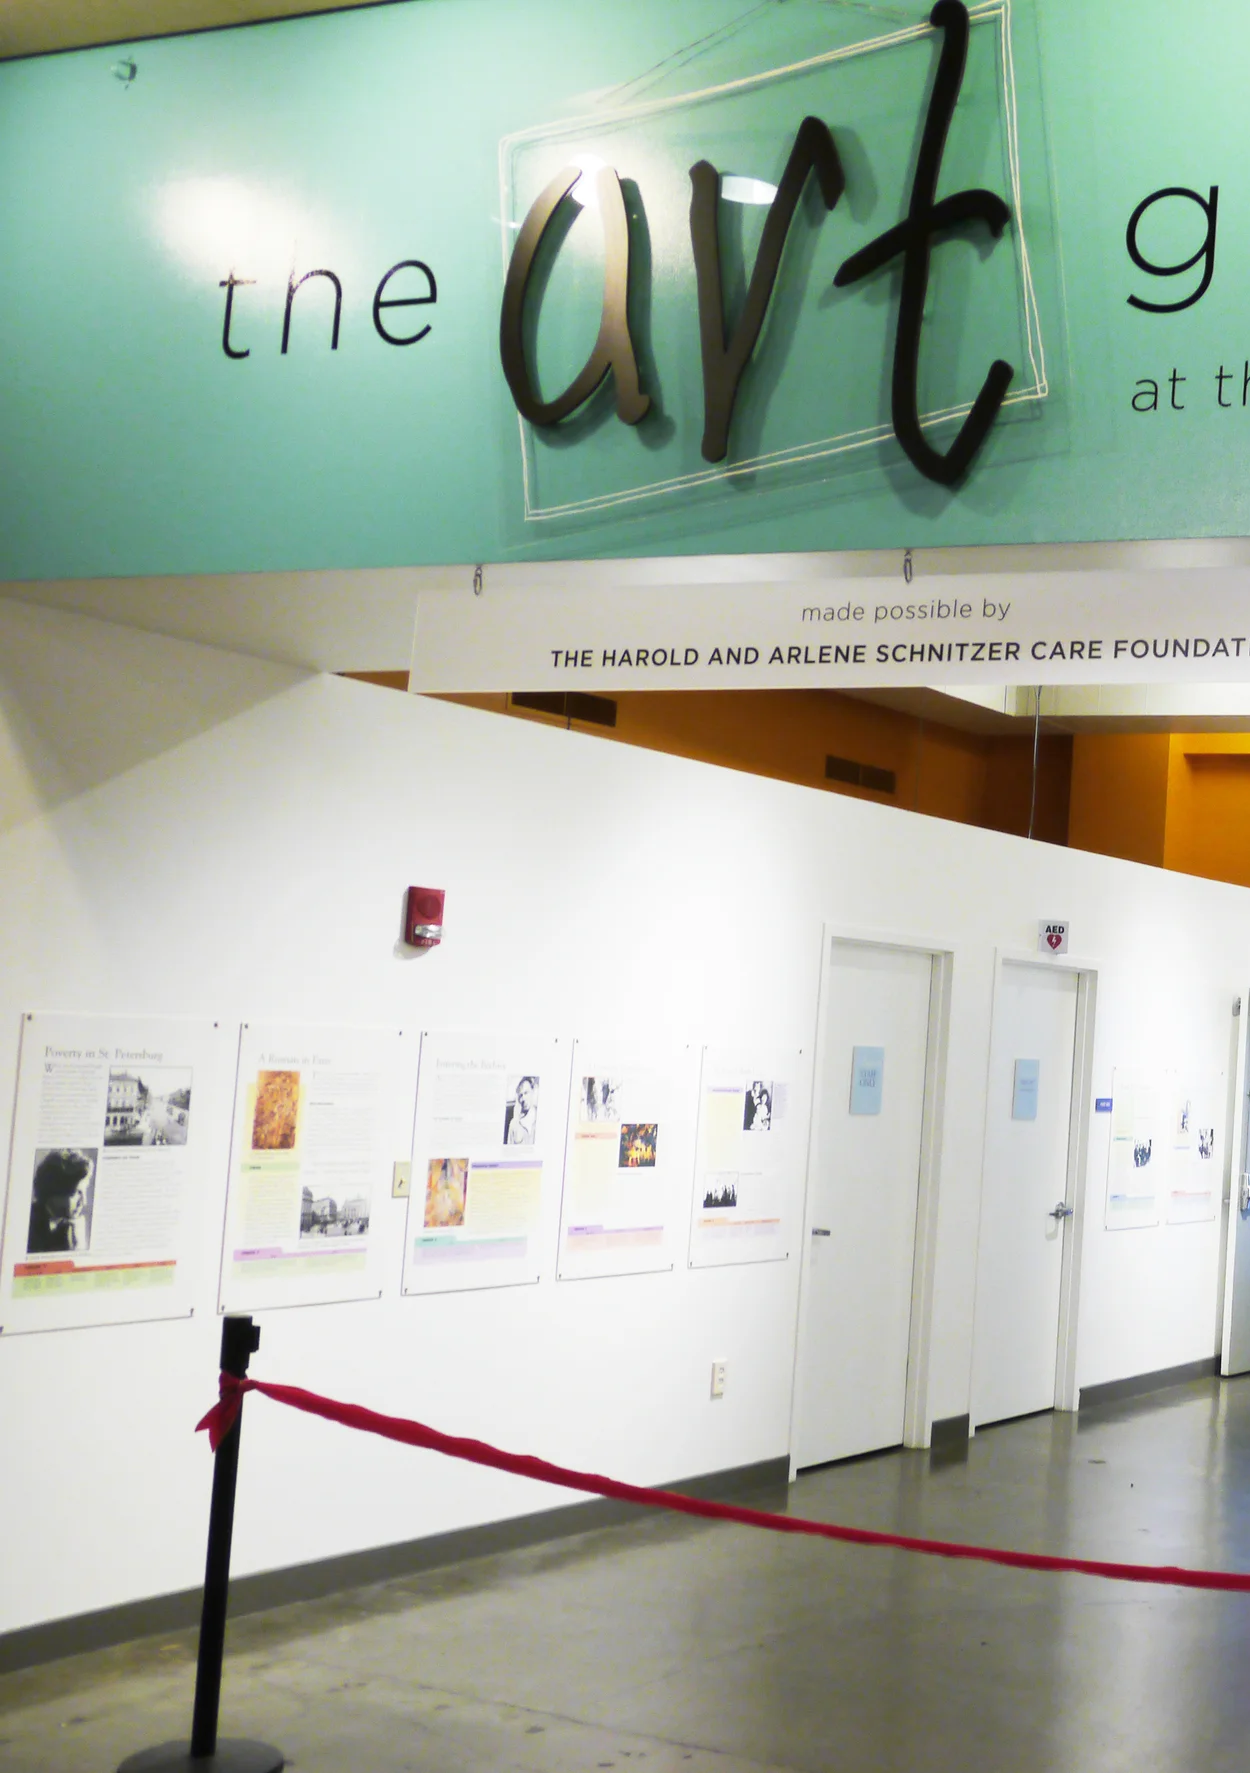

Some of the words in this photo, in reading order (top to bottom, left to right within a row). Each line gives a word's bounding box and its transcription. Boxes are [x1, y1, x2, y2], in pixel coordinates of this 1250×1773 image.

[219, 250, 438, 360] the
[499, 0, 1013, 488] art
[1130, 366, 1187, 412] at
[802, 601, 865, 622] made
[873, 599, 973, 624] possible
[982, 598, 1012, 621] by
[550, 649, 594, 668] THE
[601, 647, 699, 668] HAROLD
[708, 646, 760, 667] AND
[768, 644, 867, 666] ARLENE
[875, 642, 1021, 664] SCHNITZER
[1031, 639, 1103, 661] CARE
[1045, 924, 1065, 934] AED
